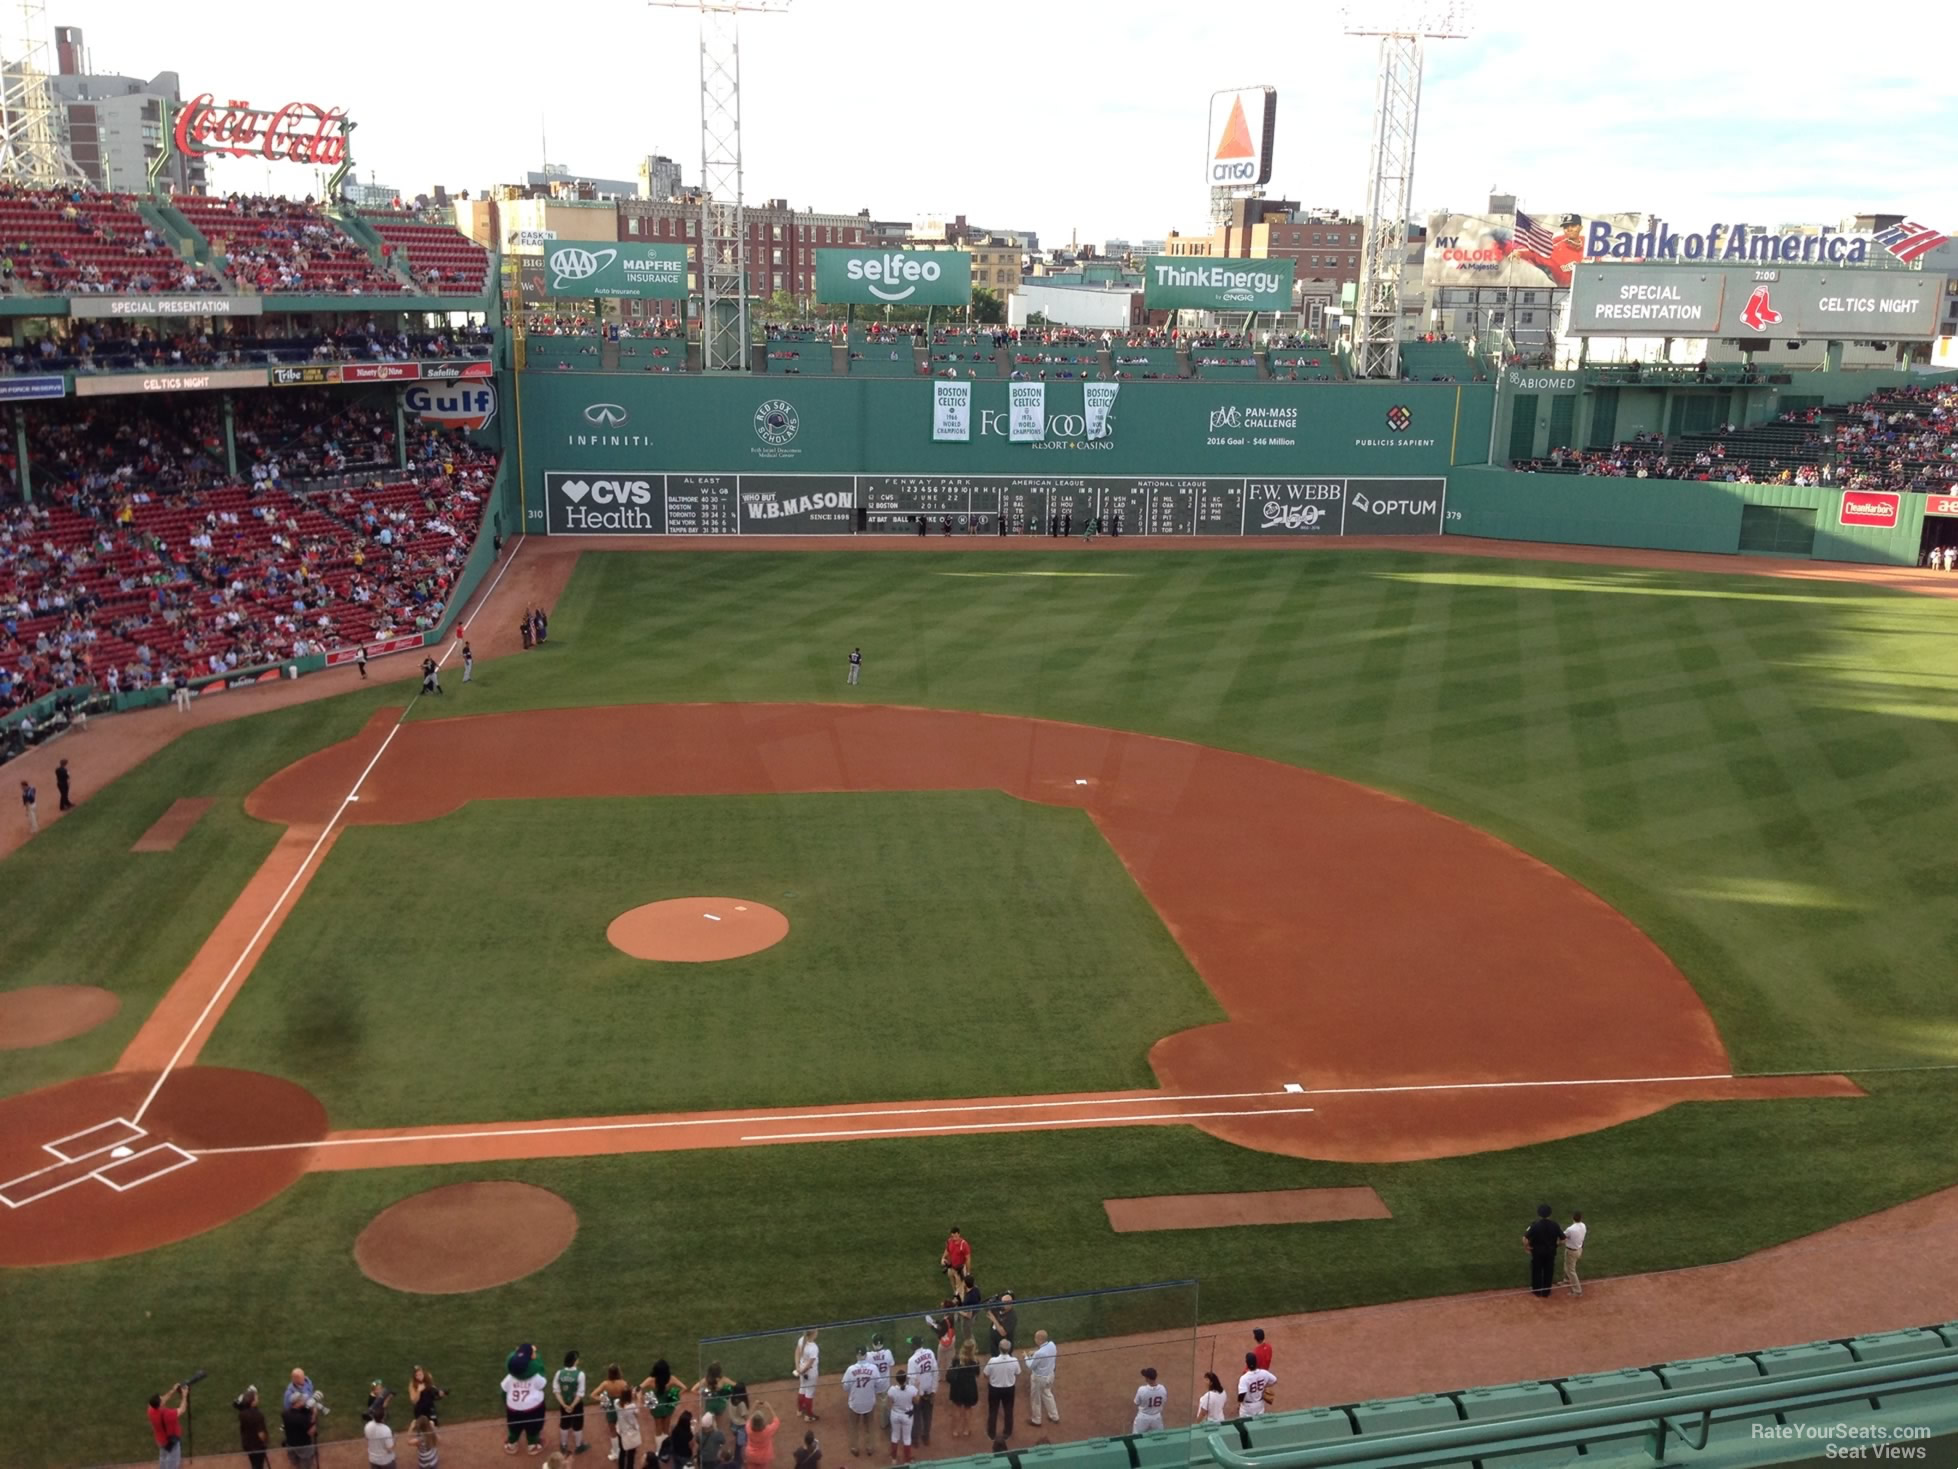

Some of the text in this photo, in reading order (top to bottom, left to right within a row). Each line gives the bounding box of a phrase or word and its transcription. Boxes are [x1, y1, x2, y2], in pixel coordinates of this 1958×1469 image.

[175, 93, 348, 165] Coca-Cola
[1213, 162, 1254, 180] CITGO
[1436, 237, 1459, 248] MY
[1588, 221, 1866, 262] Bank of America
[1442, 248, 1504, 261] COLORS
[522, 259, 545, 267] BIG
[552, 249, 595, 279] AAA
[624, 260, 682, 271] MAPFRE
[627, 274, 678, 283] INSURANCE
[1155, 266, 1278, 293] ThinkEnergy
[1755, 271, 1775, 280] 7:00
[521, 282, 534, 290] We
[1620, 286, 1680, 300] SPECIAL
[112, 302, 230, 313] SPECIAL PRESENTATION
[1595, 304, 1701, 319] PRESENTATION
[1819, 298, 1919, 313] CELTICS NIGHT
[274, 368, 301, 383] Tribe
[428, 368, 460, 377] Safelite
[144, 377, 209, 390] CELTICS NIGHT
[1519, 378, 1576, 389] ABIOMED
[938, 388, 967, 396] BOSTON
[1012, 388, 1042, 397] BOSTON
[1087, 389, 1116, 398] BOSTON
[405, 388, 489, 412] Gulf
[939, 398, 966, 406] CELTICS
[1014, 398, 1040, 407] CELTICS
[1088, 398, 1111, 407] CELTIC
[756, 402, 791, 421] RED SOX
[1246, 408, 1297, 417] PAN-MASS
[980, 410, 1112, 436] FOOOS
[1244, 419, 1296, 428] CHALLENGE
[758, 418, 797, 443] SCHOLARS
[569, 435, 648, 446] INFINITI
[1253, 438, 1267, 446] $46
[1269, 438, 1295, 446] Million
[592, 481, 651, 504] CVS
[1249, 485, 1340, 500] F.W. WEBB
[1372, 500, 1436, 515] OPTUM
[528, 510, 543, 518] 310
[566, 506, 652, 529] Health
[1281, 504, 1319, 529] 150
[1446, 511, 1461, 520] 379
[919, 1361, 931, 1374] 16
[856, 1377, 871, 1388] 17
[1250, 1379, 1264, 1392] 65
[512, 1390, 530, 1402] 97
